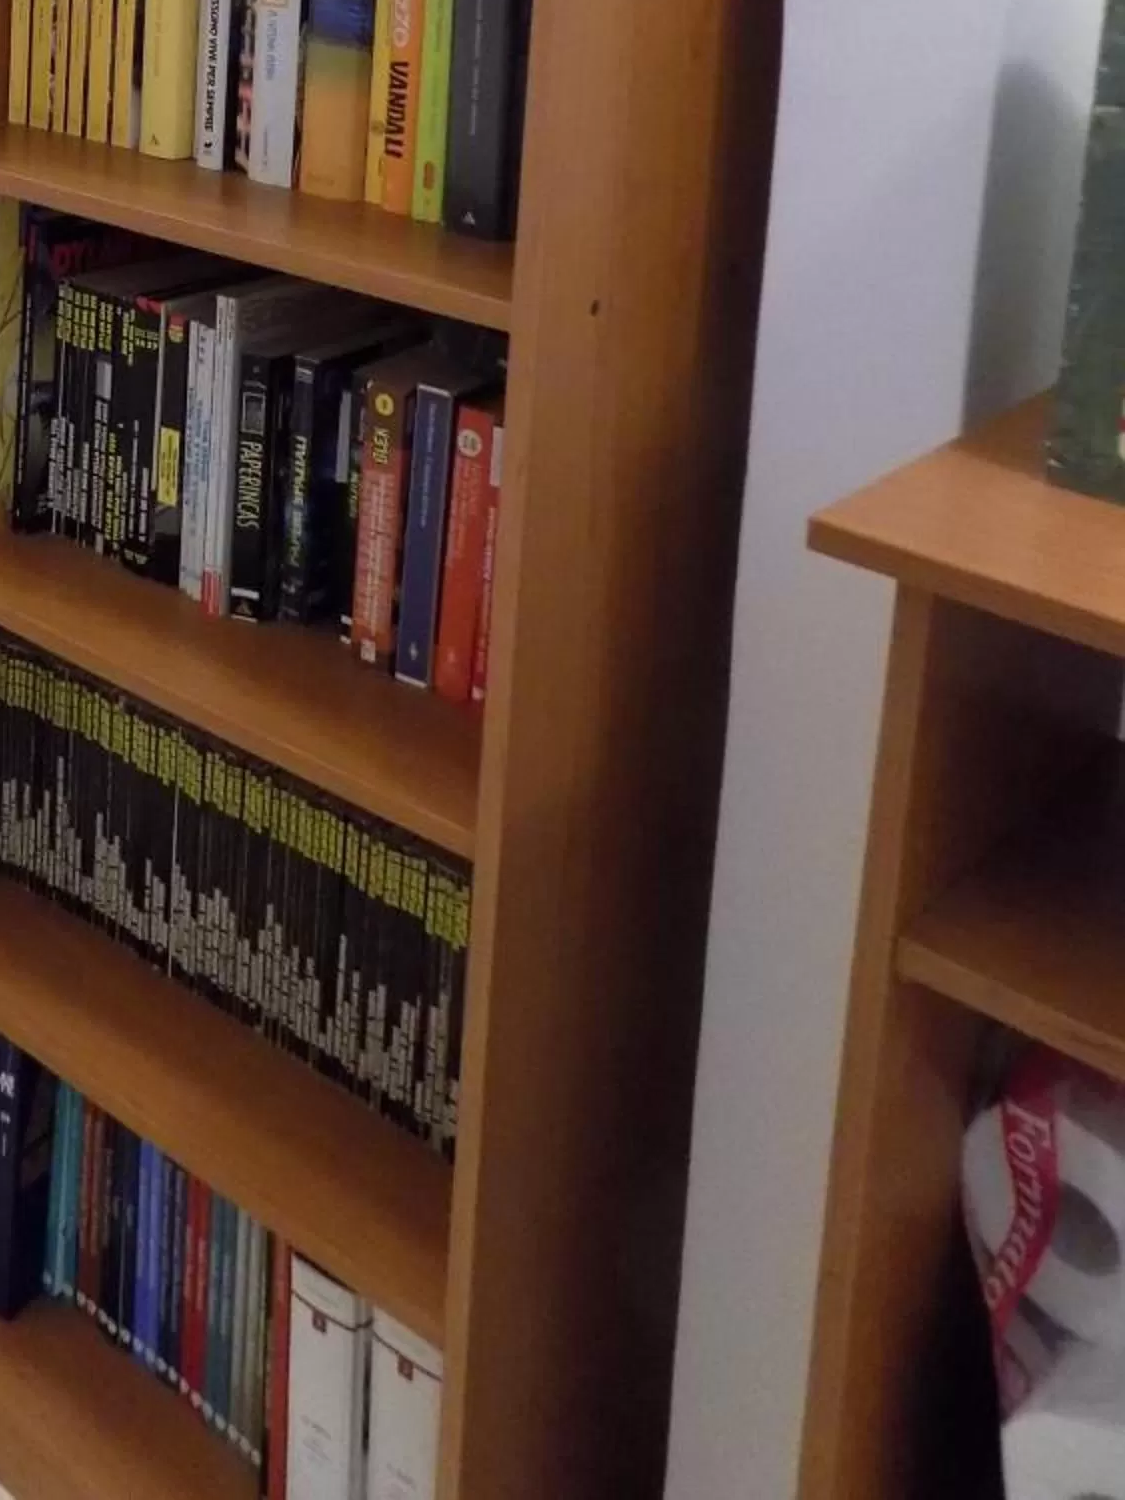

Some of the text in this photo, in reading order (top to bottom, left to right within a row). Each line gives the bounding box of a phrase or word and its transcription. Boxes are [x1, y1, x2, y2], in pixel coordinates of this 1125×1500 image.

[205, 66, 217, 89] PER
[384, 60, 410, 159] VANDALI
[237, 441, 264, 530] PAPERINCAS
